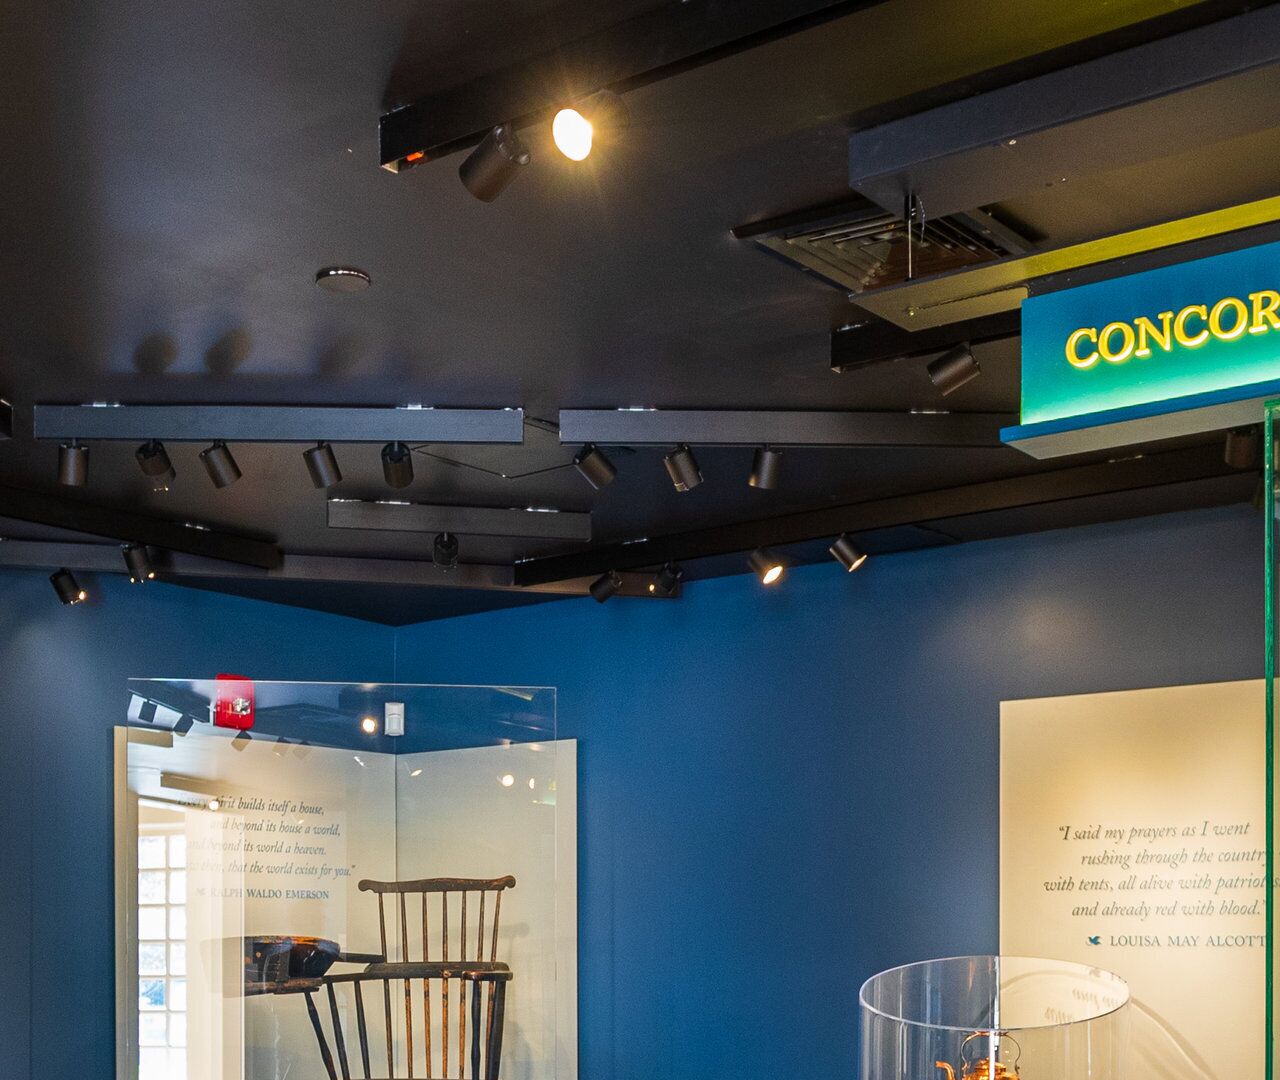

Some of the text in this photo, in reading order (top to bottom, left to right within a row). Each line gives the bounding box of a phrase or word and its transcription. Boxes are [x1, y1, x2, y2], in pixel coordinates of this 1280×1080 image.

[237, 797, 324, 816] builds itself a house,
[1073, 825, 1102, 841] said
[1104, 828, 1125, 845] my
[1127, 824, 1178, 845] prayers
[1181, 827, 1196, 837] as
[1200, 821, 1209, 837] I
[1212, 822, 1250, 836] went
[243, 840, 254, 852] its
[256, 841, 283, 853] world
[293, 842, 327, 855] heaven.
[1081, 849, 1130, 870] rushing
[1135, 848, 1188, 869] through
[1192, 847, 1213, 863] the
[1218, 850, 1266, 867] countr
[249, 860, 264, 873] the
[266, 861, 293, 874] world
[295, 863, 319, 876] exists
[318, 863, 332, 880] for
[1043, 876, 1074, 891] with
[1078, 878, 1114, 892] tents,
[1118, 875, 1137, 890] all
[1139, 874, 1172, 890] alive
[1178, 874, 1212, 889] with
[247, 889, 283, 899] WALDO
[286, 889, 330, 900] EMERSON
[1072, 901, 1099, 917] and
[1101, 901, 1150, 922] already
[1155, 900, 1178, 916] red
[1181, 900, 1215, 916] with
[1110, 935, 1266, 947] LOUISA MAY ALCOTT
